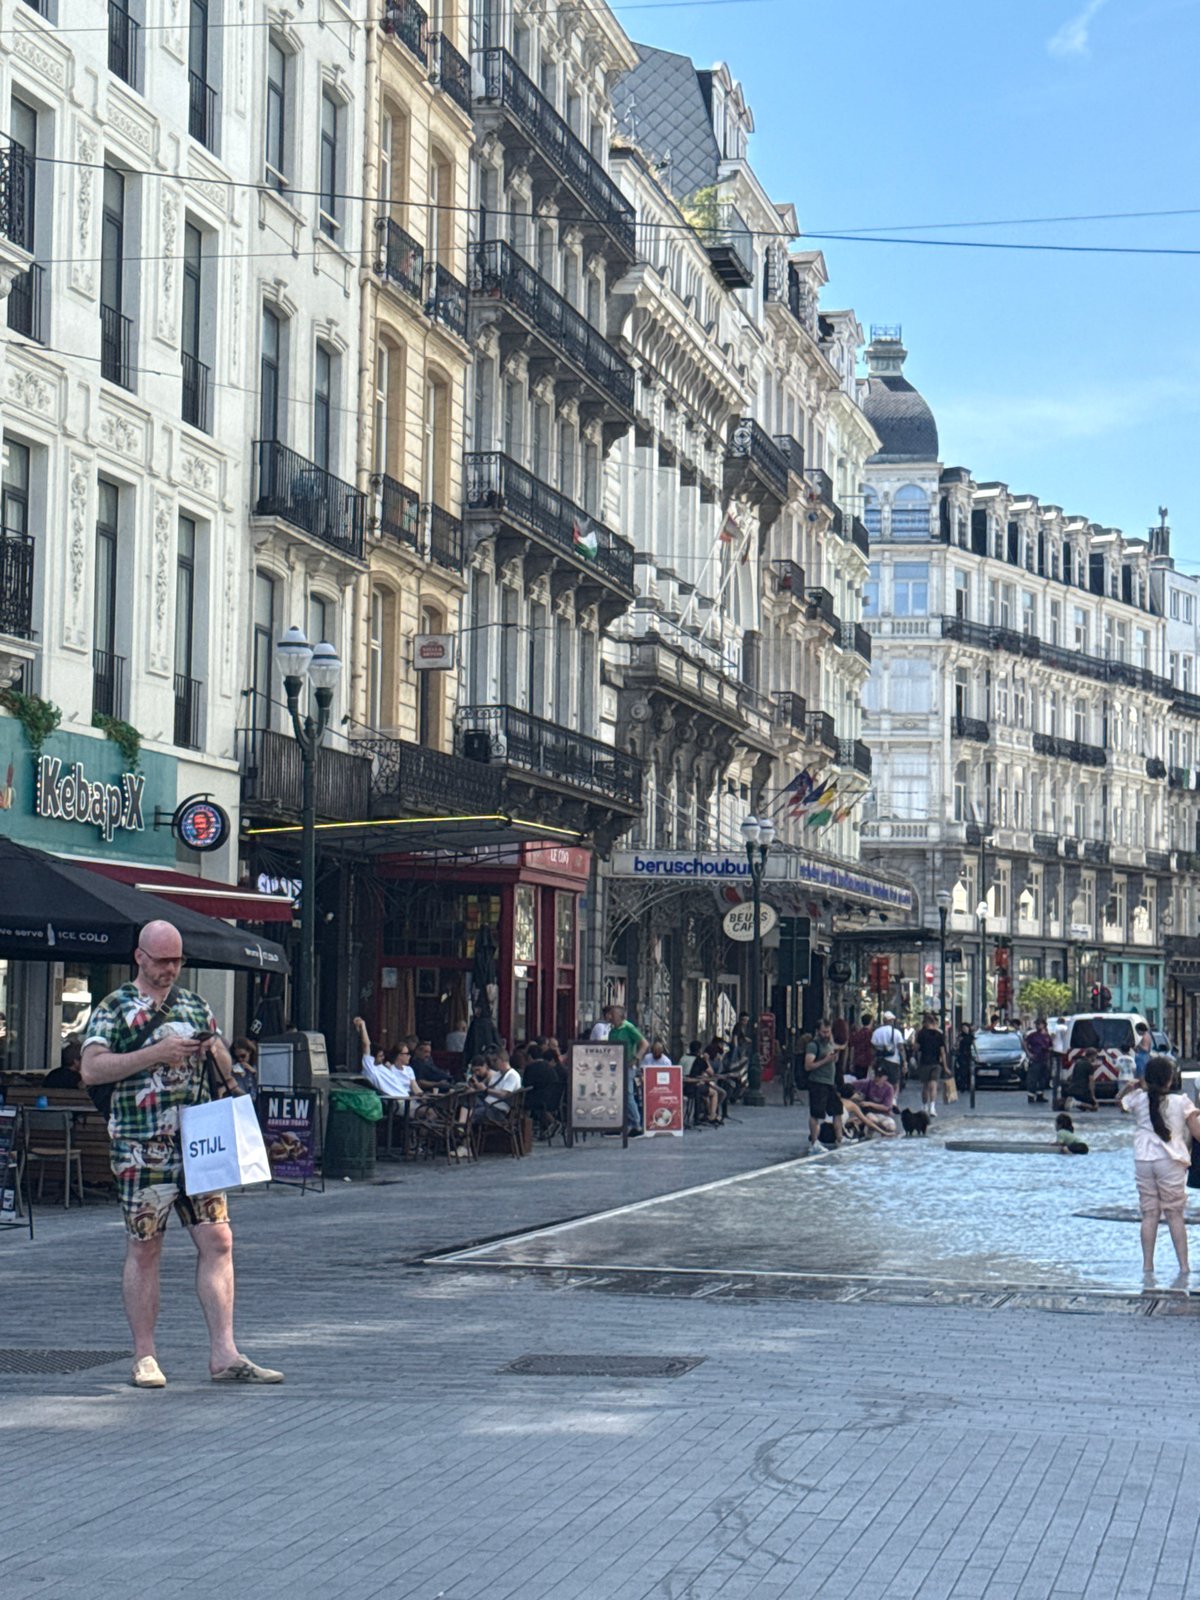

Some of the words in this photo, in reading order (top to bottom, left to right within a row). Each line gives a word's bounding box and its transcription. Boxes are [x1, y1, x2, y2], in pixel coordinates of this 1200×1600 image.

[730, 911, 768, 922] BEUS
[732, 922, 755, 932] CAF
[58, 931, 77, 940] ICE
[79, 932, 109, 943] COLD
[268, 1098, 309, 1119] NEW
[189, 1135, 226, 1158] STIJL
